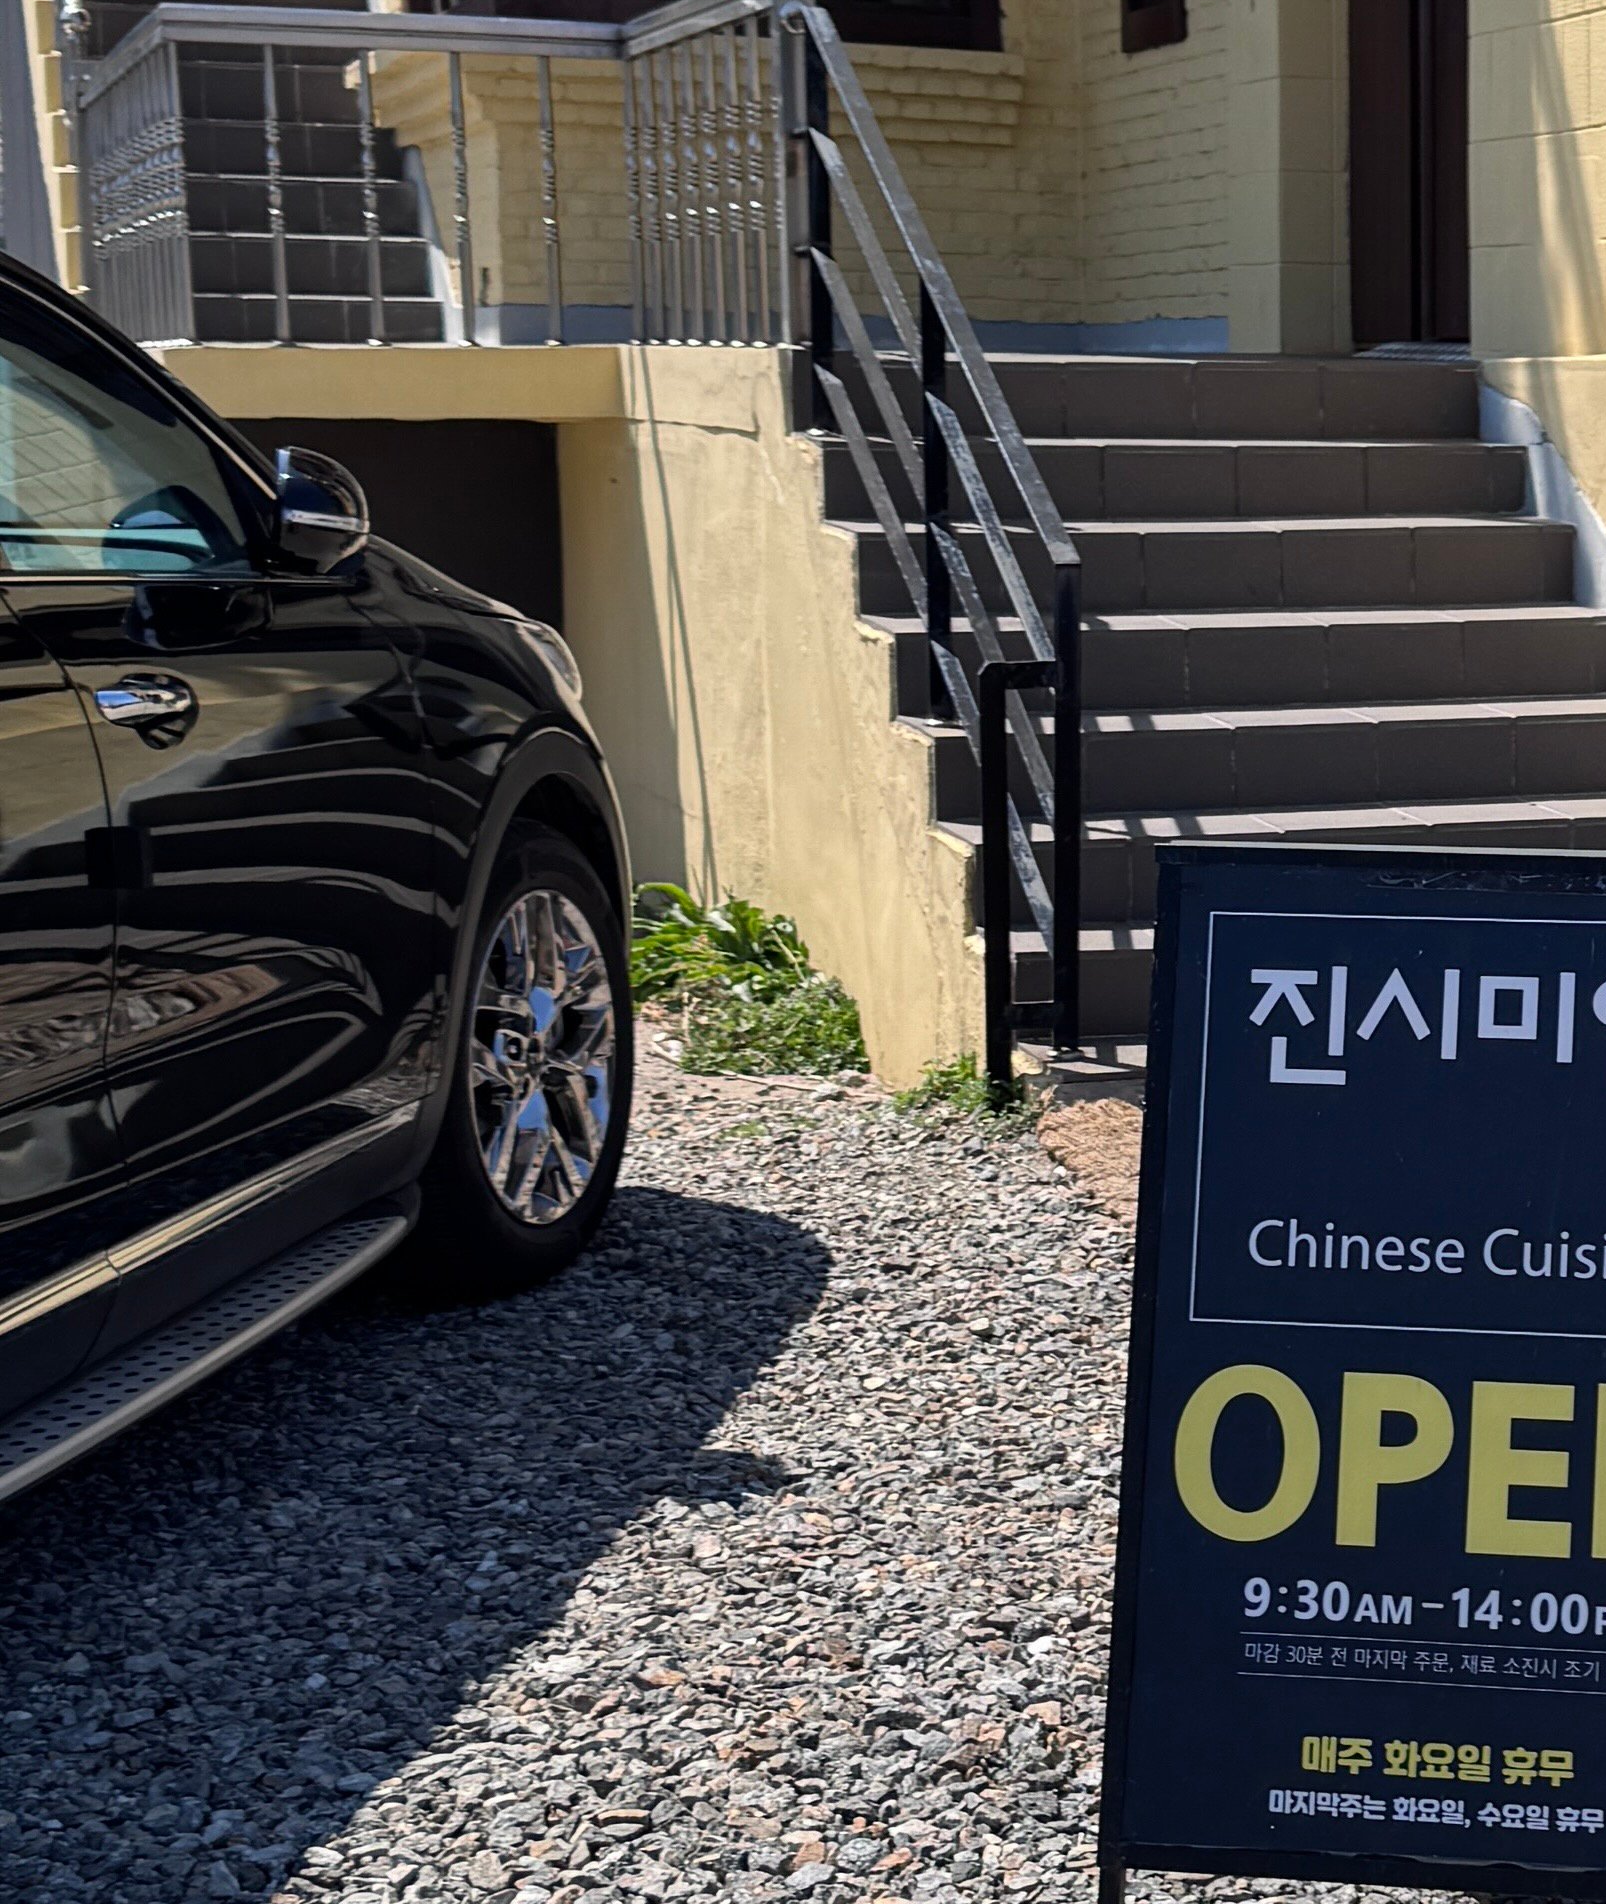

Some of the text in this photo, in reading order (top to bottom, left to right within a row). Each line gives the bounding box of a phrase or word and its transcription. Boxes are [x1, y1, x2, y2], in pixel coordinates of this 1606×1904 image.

[1249, 1219, 1464, 1273] Chinese
[1245, 1644, 1280, 1663] 마감
[1286, 1646, 1323, 1665] 30분
[1331, 1648, 1346, 1666] 전
[1355, 1649, 1407, 1670] 마지막
[1414, 1652, 1453, 1672] 주문,
[1461, 1655, 1496, 1674] 재료
[1503, 1658, 1556, 1678] 소진시
[1564, 1661, 1599, 1681] 조기
[1302, 1736, 1574, 1786] 매주 화요일 휴무
[1269, 1790, 1604, 1833] 마지막주는 화요일, 수요일 휴무
